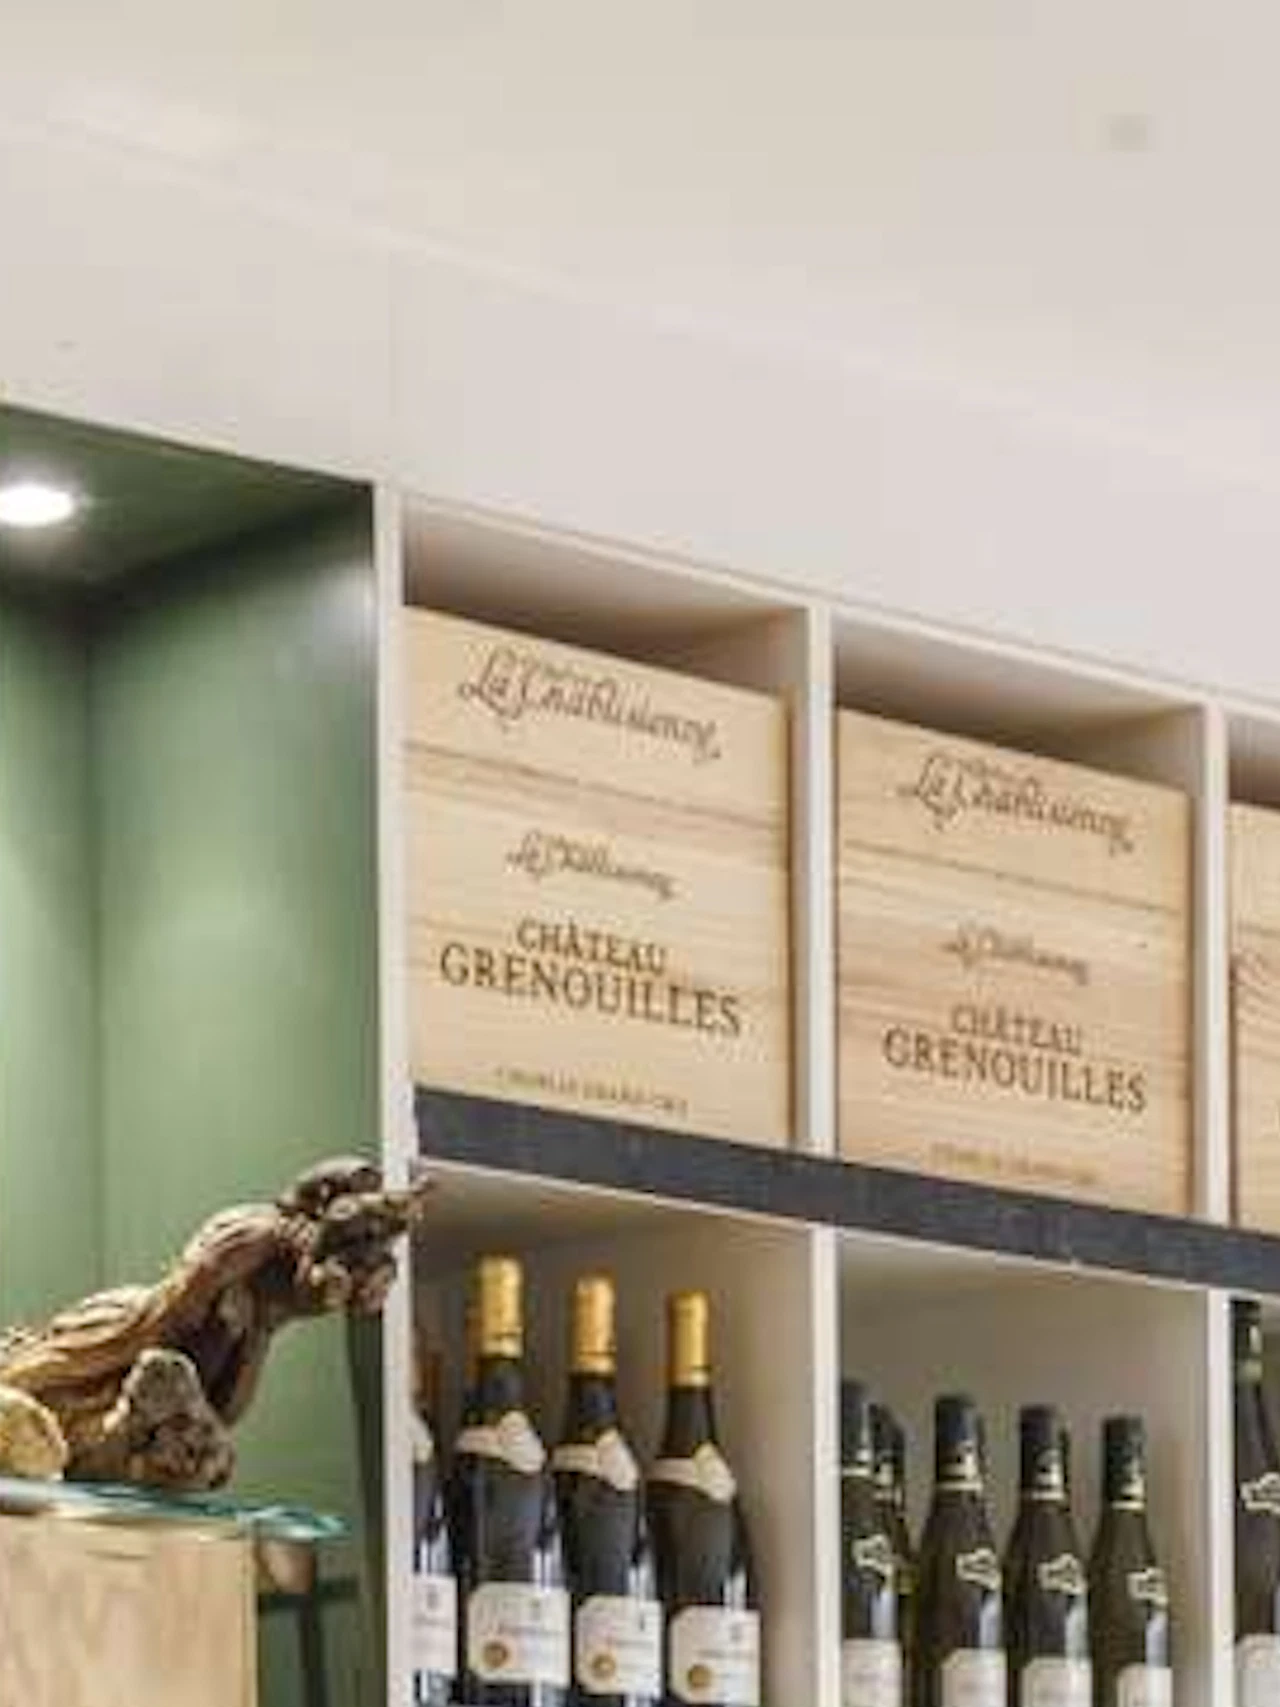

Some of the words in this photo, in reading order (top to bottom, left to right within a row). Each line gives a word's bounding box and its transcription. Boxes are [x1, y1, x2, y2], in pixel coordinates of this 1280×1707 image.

[517, 918, 667, 976] CHÂTEAU
[439, 941, 742, 1040] GRENOUILLES
[950, 1002, 1085, 1059] CHÂTEAU
[882, 1025, 1148, 1115] GRENOUILLES
